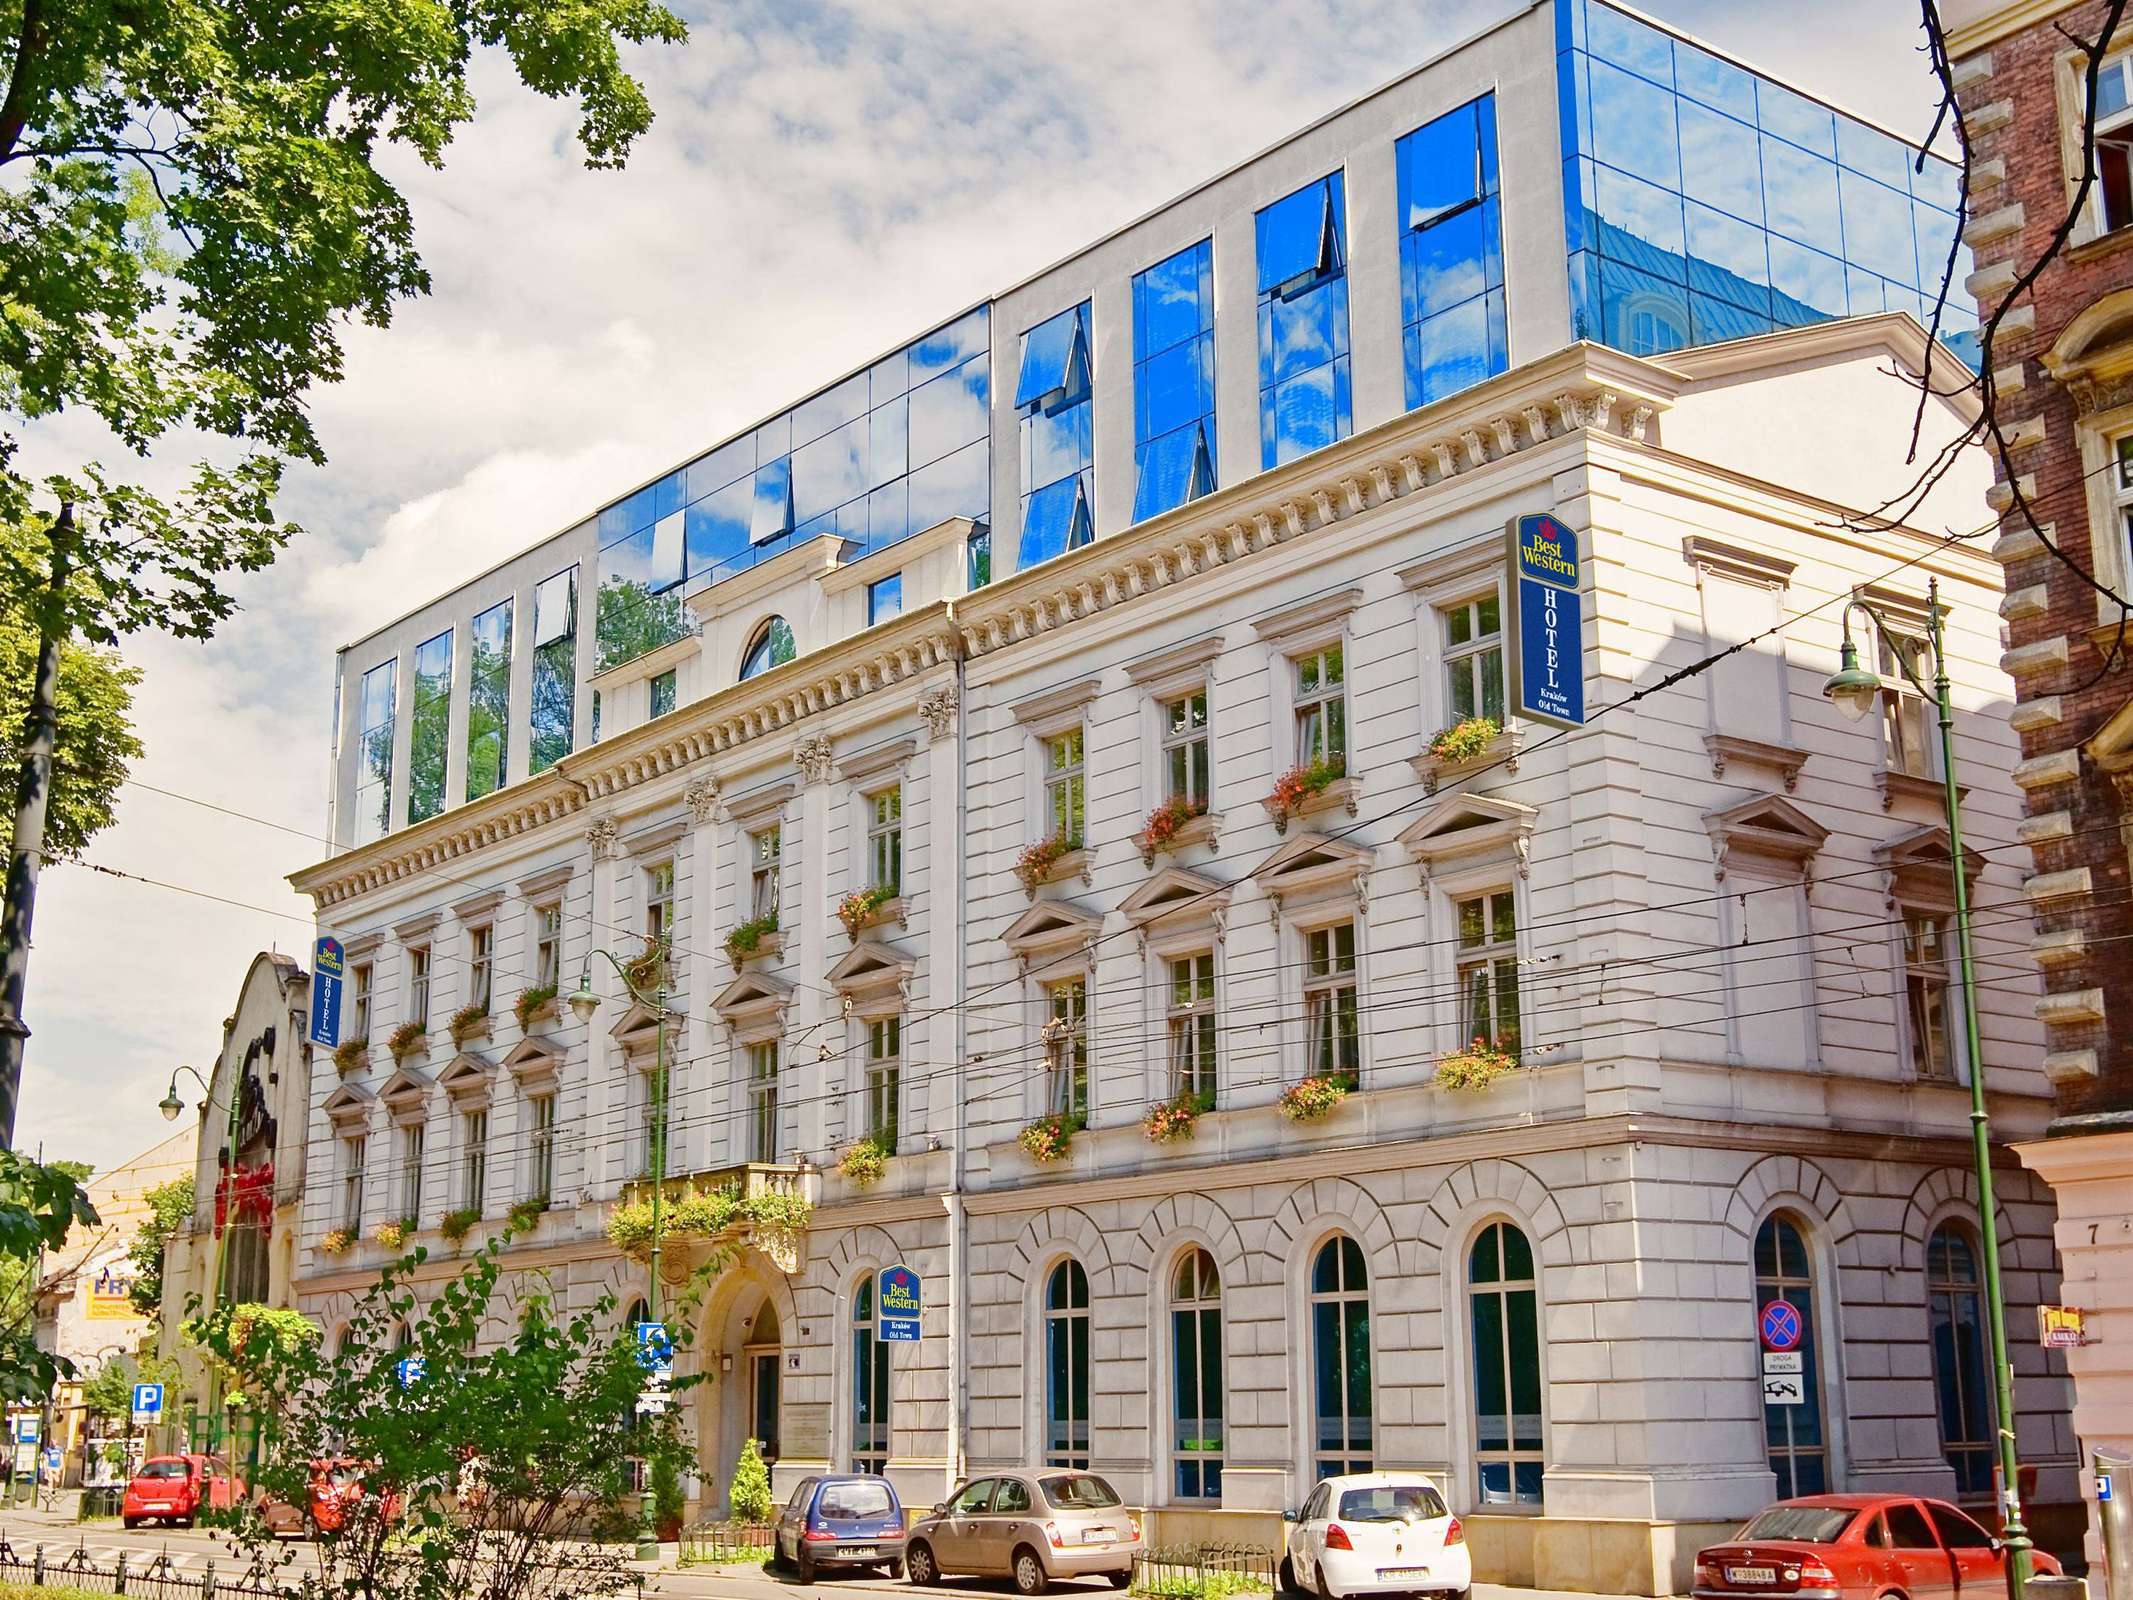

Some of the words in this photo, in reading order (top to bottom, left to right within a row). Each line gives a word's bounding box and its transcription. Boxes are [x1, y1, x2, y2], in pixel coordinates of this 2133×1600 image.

[1533, 534, 1562, 559] Best
[1522, 546, 1576, 578] Western
[1543, 587, 1559, 689] HOTEL
[1540, 687, 1568, 704] Kraków
[1538, 700, 1551, 712] Old
[1552, 703, 1570, 717] Town
[317, 953, 342, 971] Western
[323, 947, 337, 961] Best
[322, 976, 332, 1031] HOTEL
[2088, 1223, 2099, 1245] 7
[890, 1283, 911, 1298] Best
[882, 1293, 918, 1310] Western
[140, 1387, 157, 1409] P
